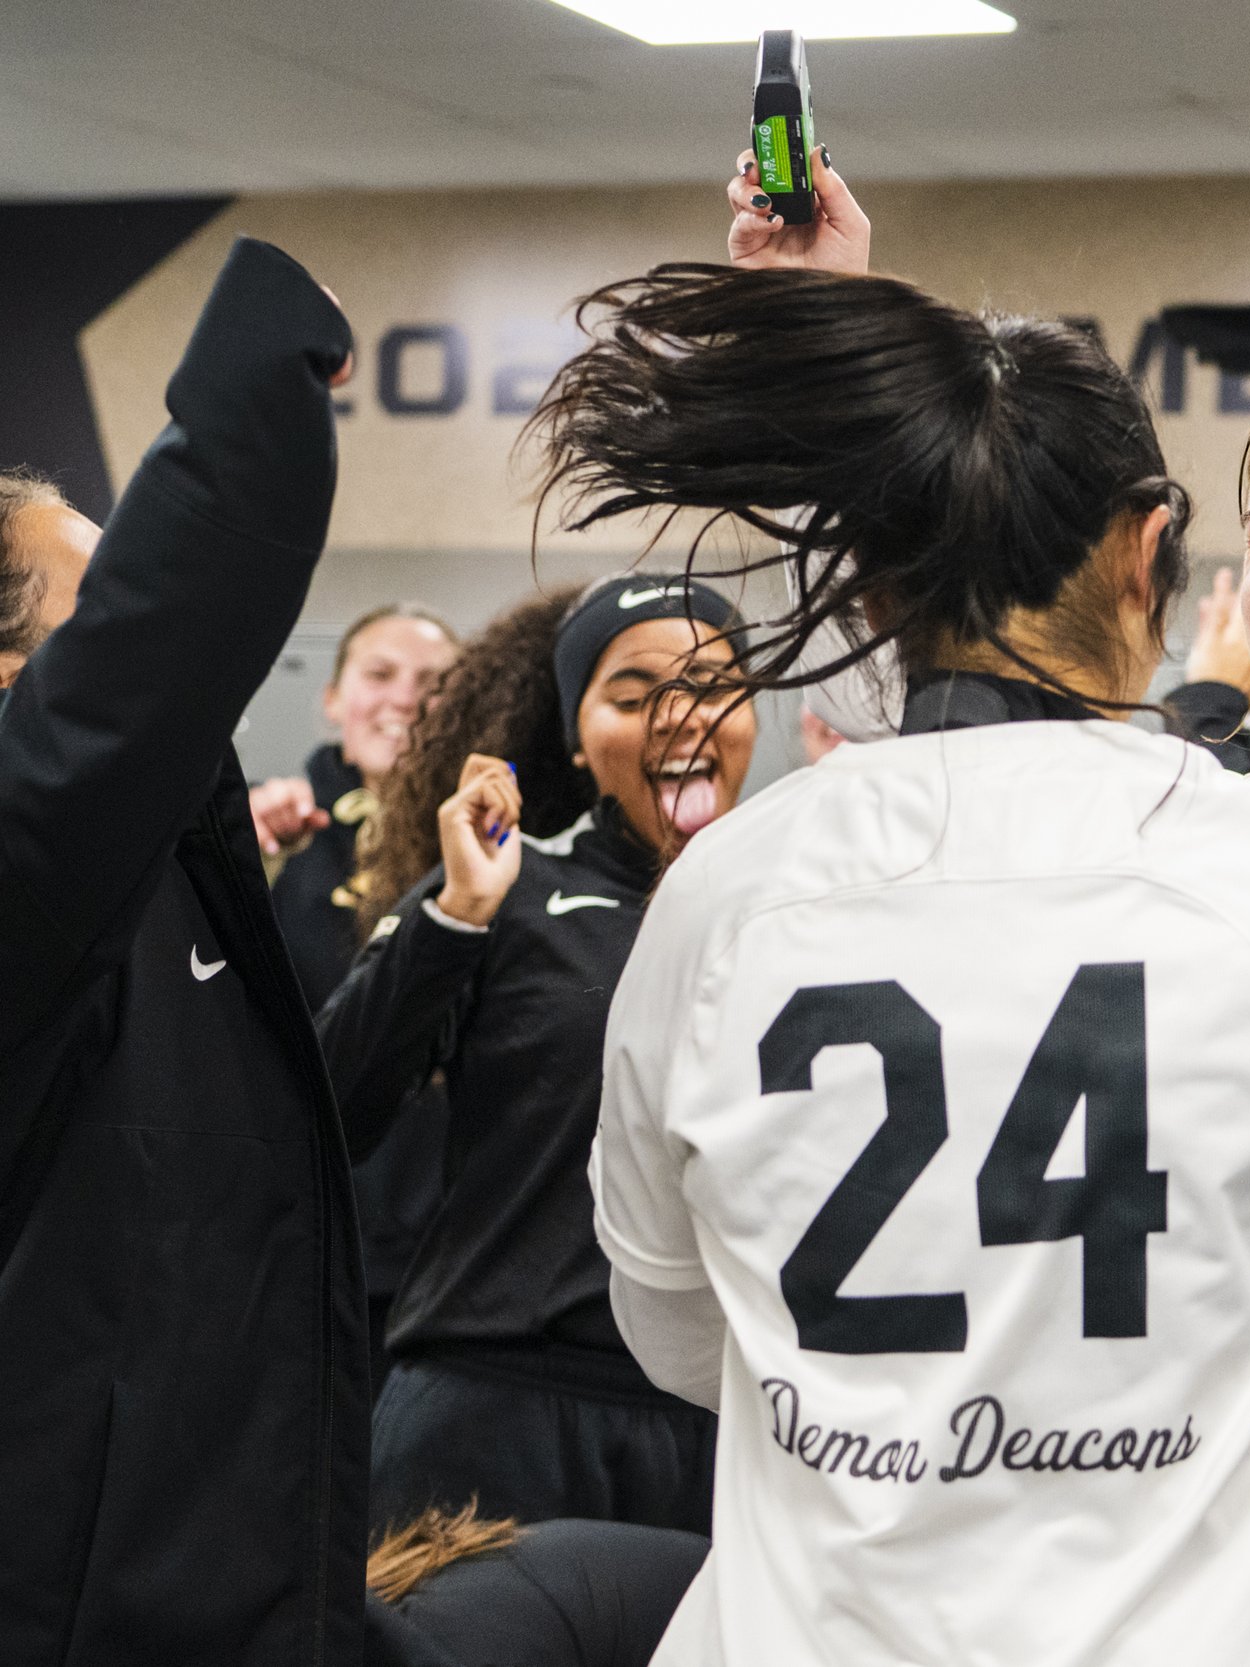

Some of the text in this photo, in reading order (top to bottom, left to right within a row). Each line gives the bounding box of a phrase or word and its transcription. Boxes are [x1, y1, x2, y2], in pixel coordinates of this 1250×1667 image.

[757, 960, 1169, 1355] 24
[761, 1377, 1201, 1484] Demon Deacons
